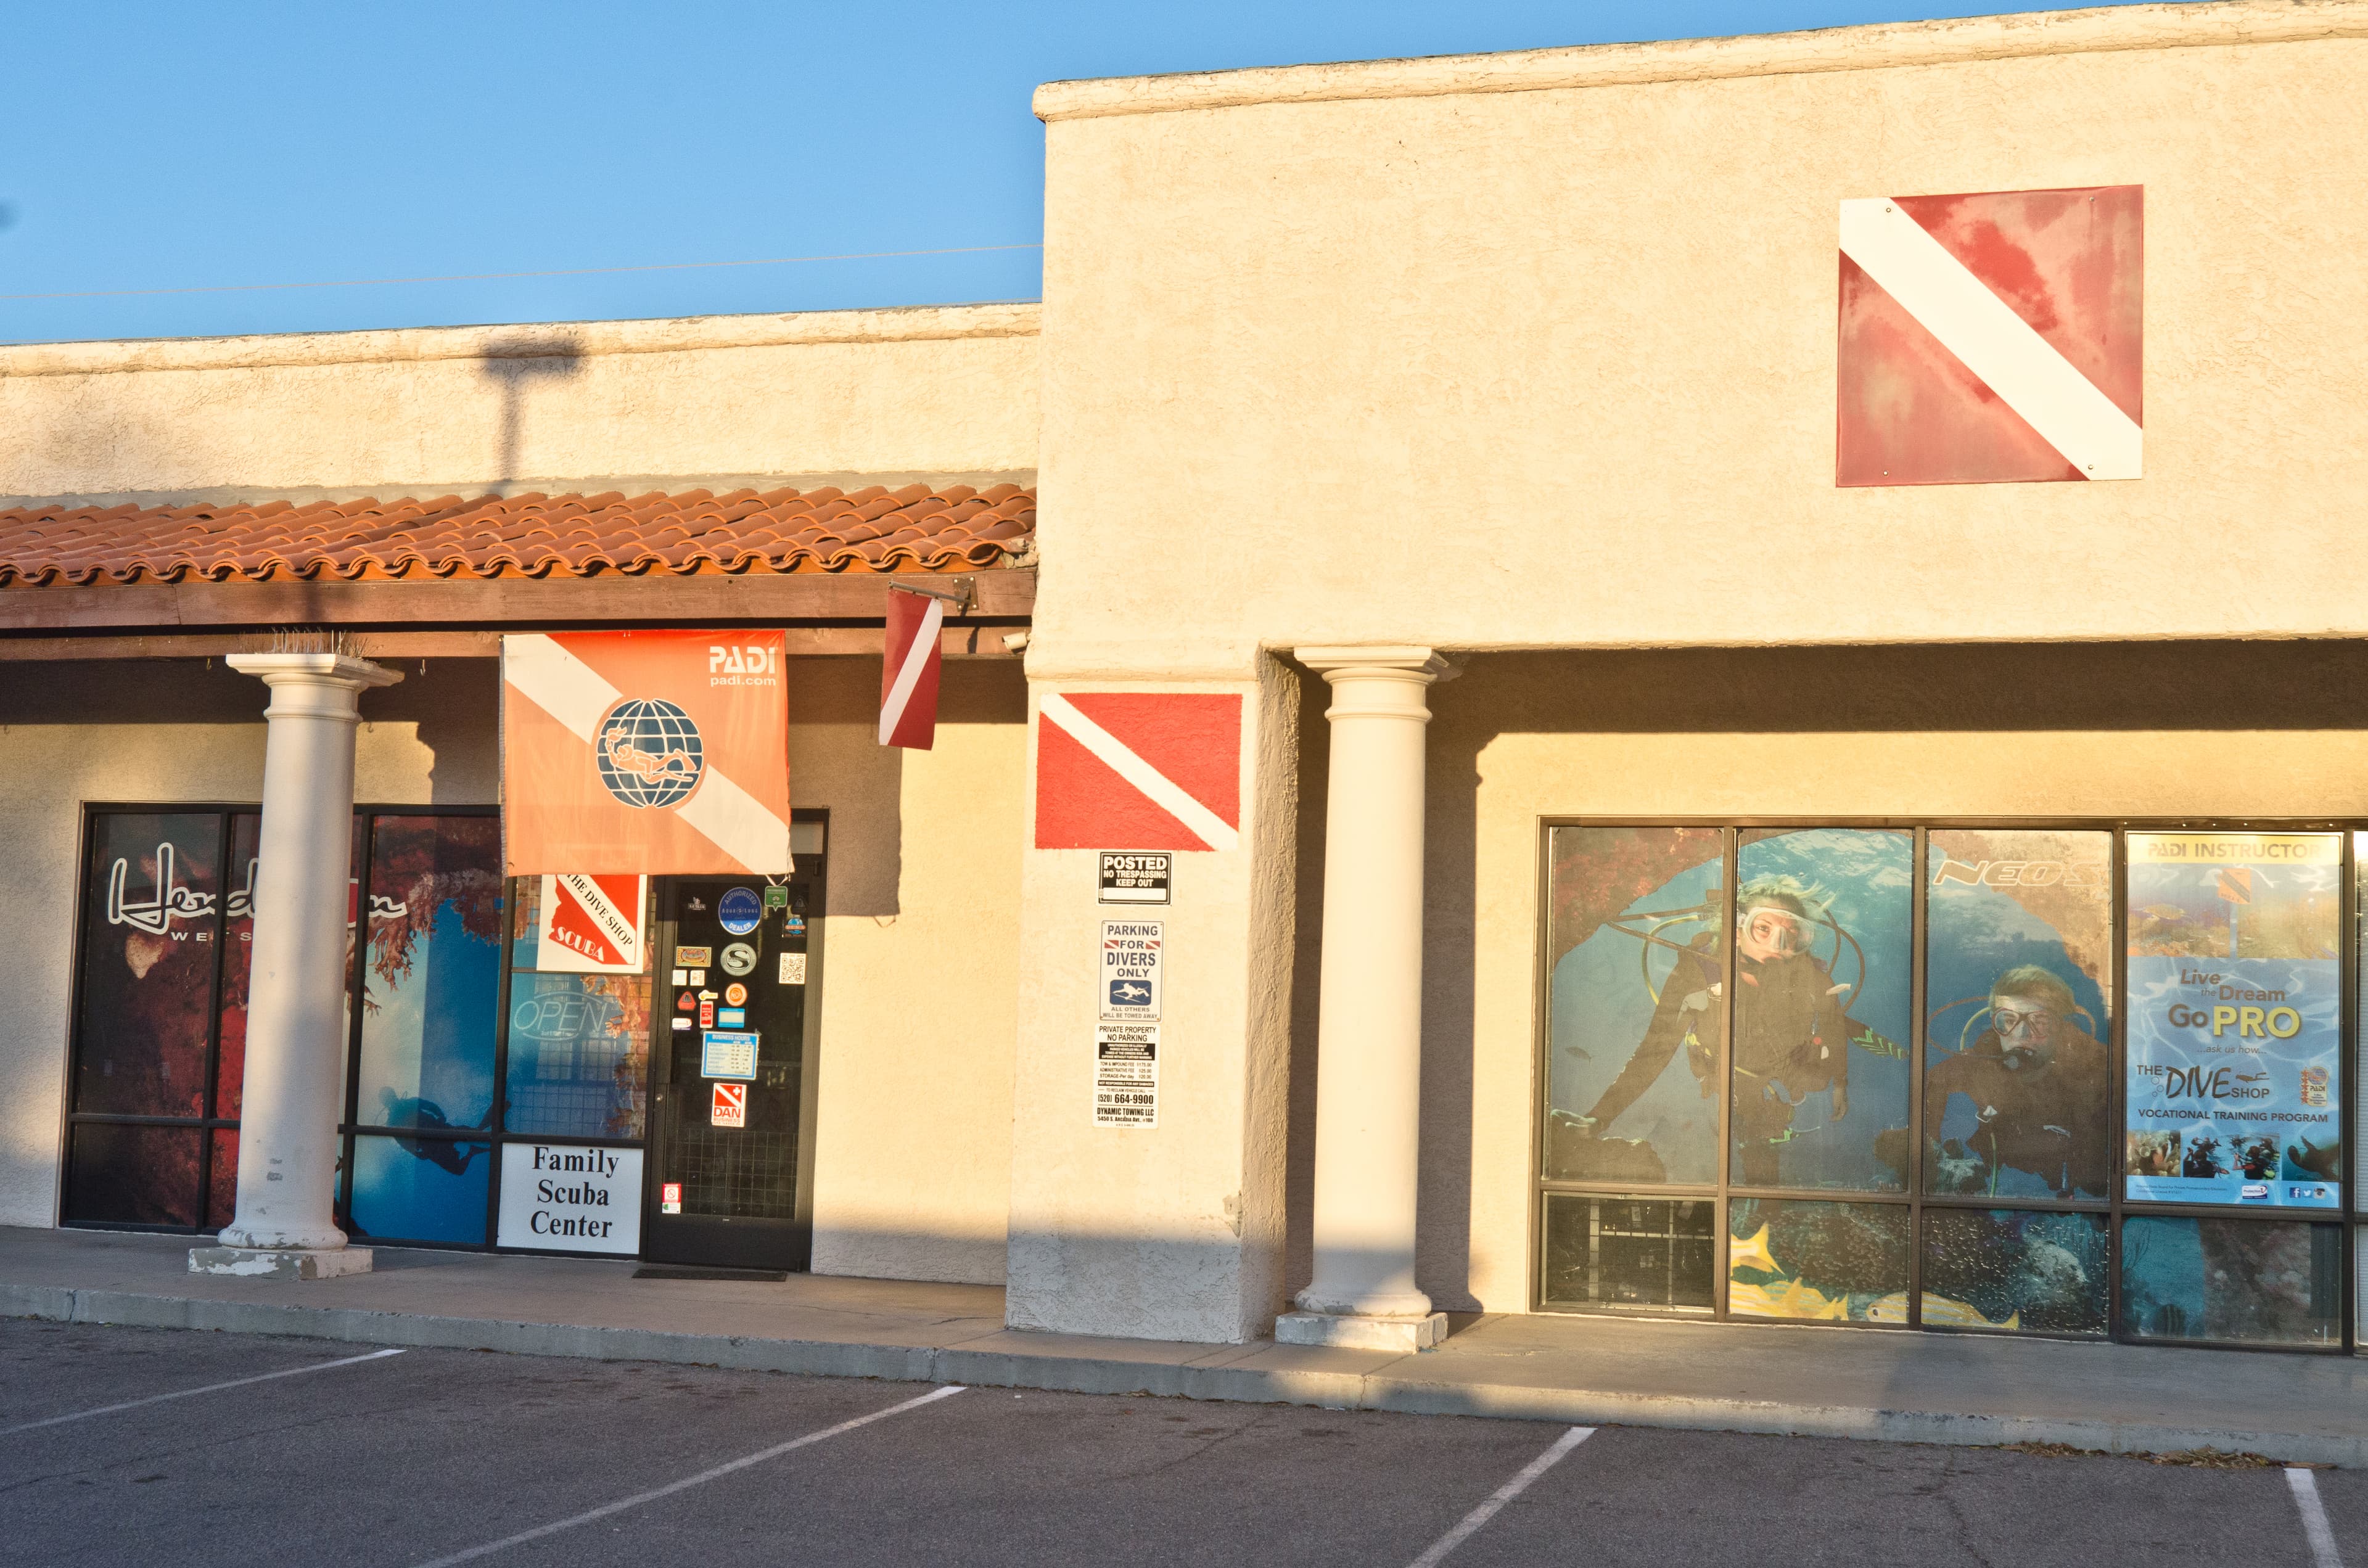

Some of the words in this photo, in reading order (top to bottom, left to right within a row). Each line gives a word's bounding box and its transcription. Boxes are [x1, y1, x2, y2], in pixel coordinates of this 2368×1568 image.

[710, 646, 775, 674] PADI
[710, 675, 776, 688] padi.com
[2147, 843, 2187, 857] PADI
[2195, 844, 2321, 858] INSTRUCTOR
[1104, 856, 1167, 869] POSTED
[1103, 870, 1114, 878] NO
[1116, 870, 1167, 879] TRESPASSING
[1116, 879, 1136, 887] KEEP
[1138, 879, 1153, 887] OUT
[725, 890, 757, 905] AUTHORIZED
[585, 890, 609, 918] DIVE
[606, 916, 633, 945] SHOP
[728, 922, 752, 932] DEALER
[1108, 926, 1158, 936] PARKING
[556, 927, 604, 962] SCUBA
[1120, 940, 1144, 949] FOR
[1107, 952, 1156, 966] DIVERS
[1117, 968, 1149, 977] ONLY
[2181, 969, 2221, 985] Live
[2201, 988, 2216, 996] the
[2219, 985, 2285, 1001] Dream
[514, 1000, 607, 1032] OPEN
[2168, 1003, 2209, 1028] Go
[2213, 1006, 2301, 1038] PRO
[1119, 1034, 1148, 1042] PARKING
[2137, 1065, 2163, 1075] THE
[2166, 1065, 2231, 1099] DIVE
[2231, 1087, 2270, 1099] SHOP
[1098, 1094, 1112, 1102] (520)
[1114, 1094, 1154, 1104] 664-9900
[714, 1107, 741, 1118] DAN
[1122, 1108, 1144, 1116] TOWING
[1145, 1109, 1154, 1117] LLC
[2137, 1109, 2210, 1119] VOCATIONAL
[2213, 1111, 2267, 1121] TRAINING
[2271, 1112, 2329, 1123] PROGRAM
[532, 1146, 620, 1178] Family
[536, 1180, 609, 1206] Scuba
[530, 1212, 613, 1238] Center
